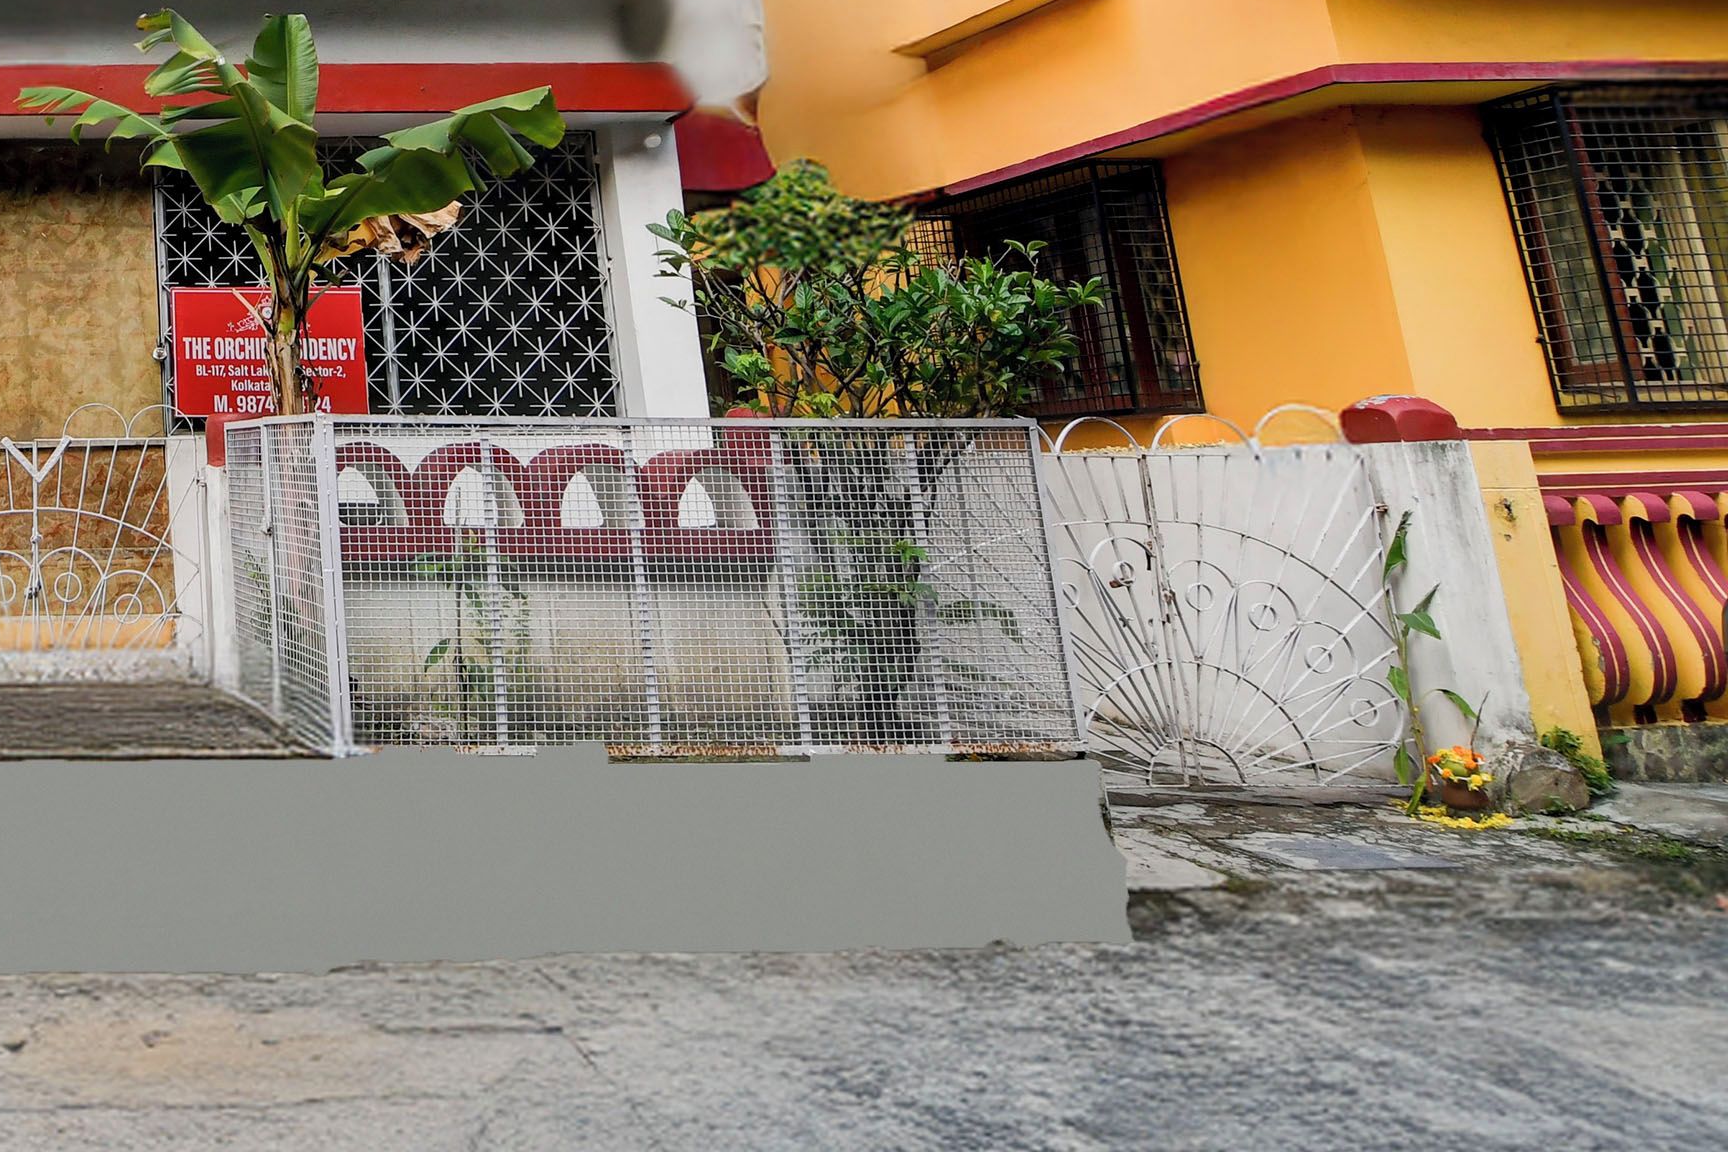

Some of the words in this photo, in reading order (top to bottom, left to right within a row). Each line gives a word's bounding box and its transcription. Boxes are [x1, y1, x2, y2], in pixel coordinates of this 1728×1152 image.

[183, 337, 211, 360] THE
[299, 338, 356, 361] IDENCY
[196, 365, 225, 377] BL-117,
[228, 365, 248, 376] Salt
[214, 395, 232, 413] M.
